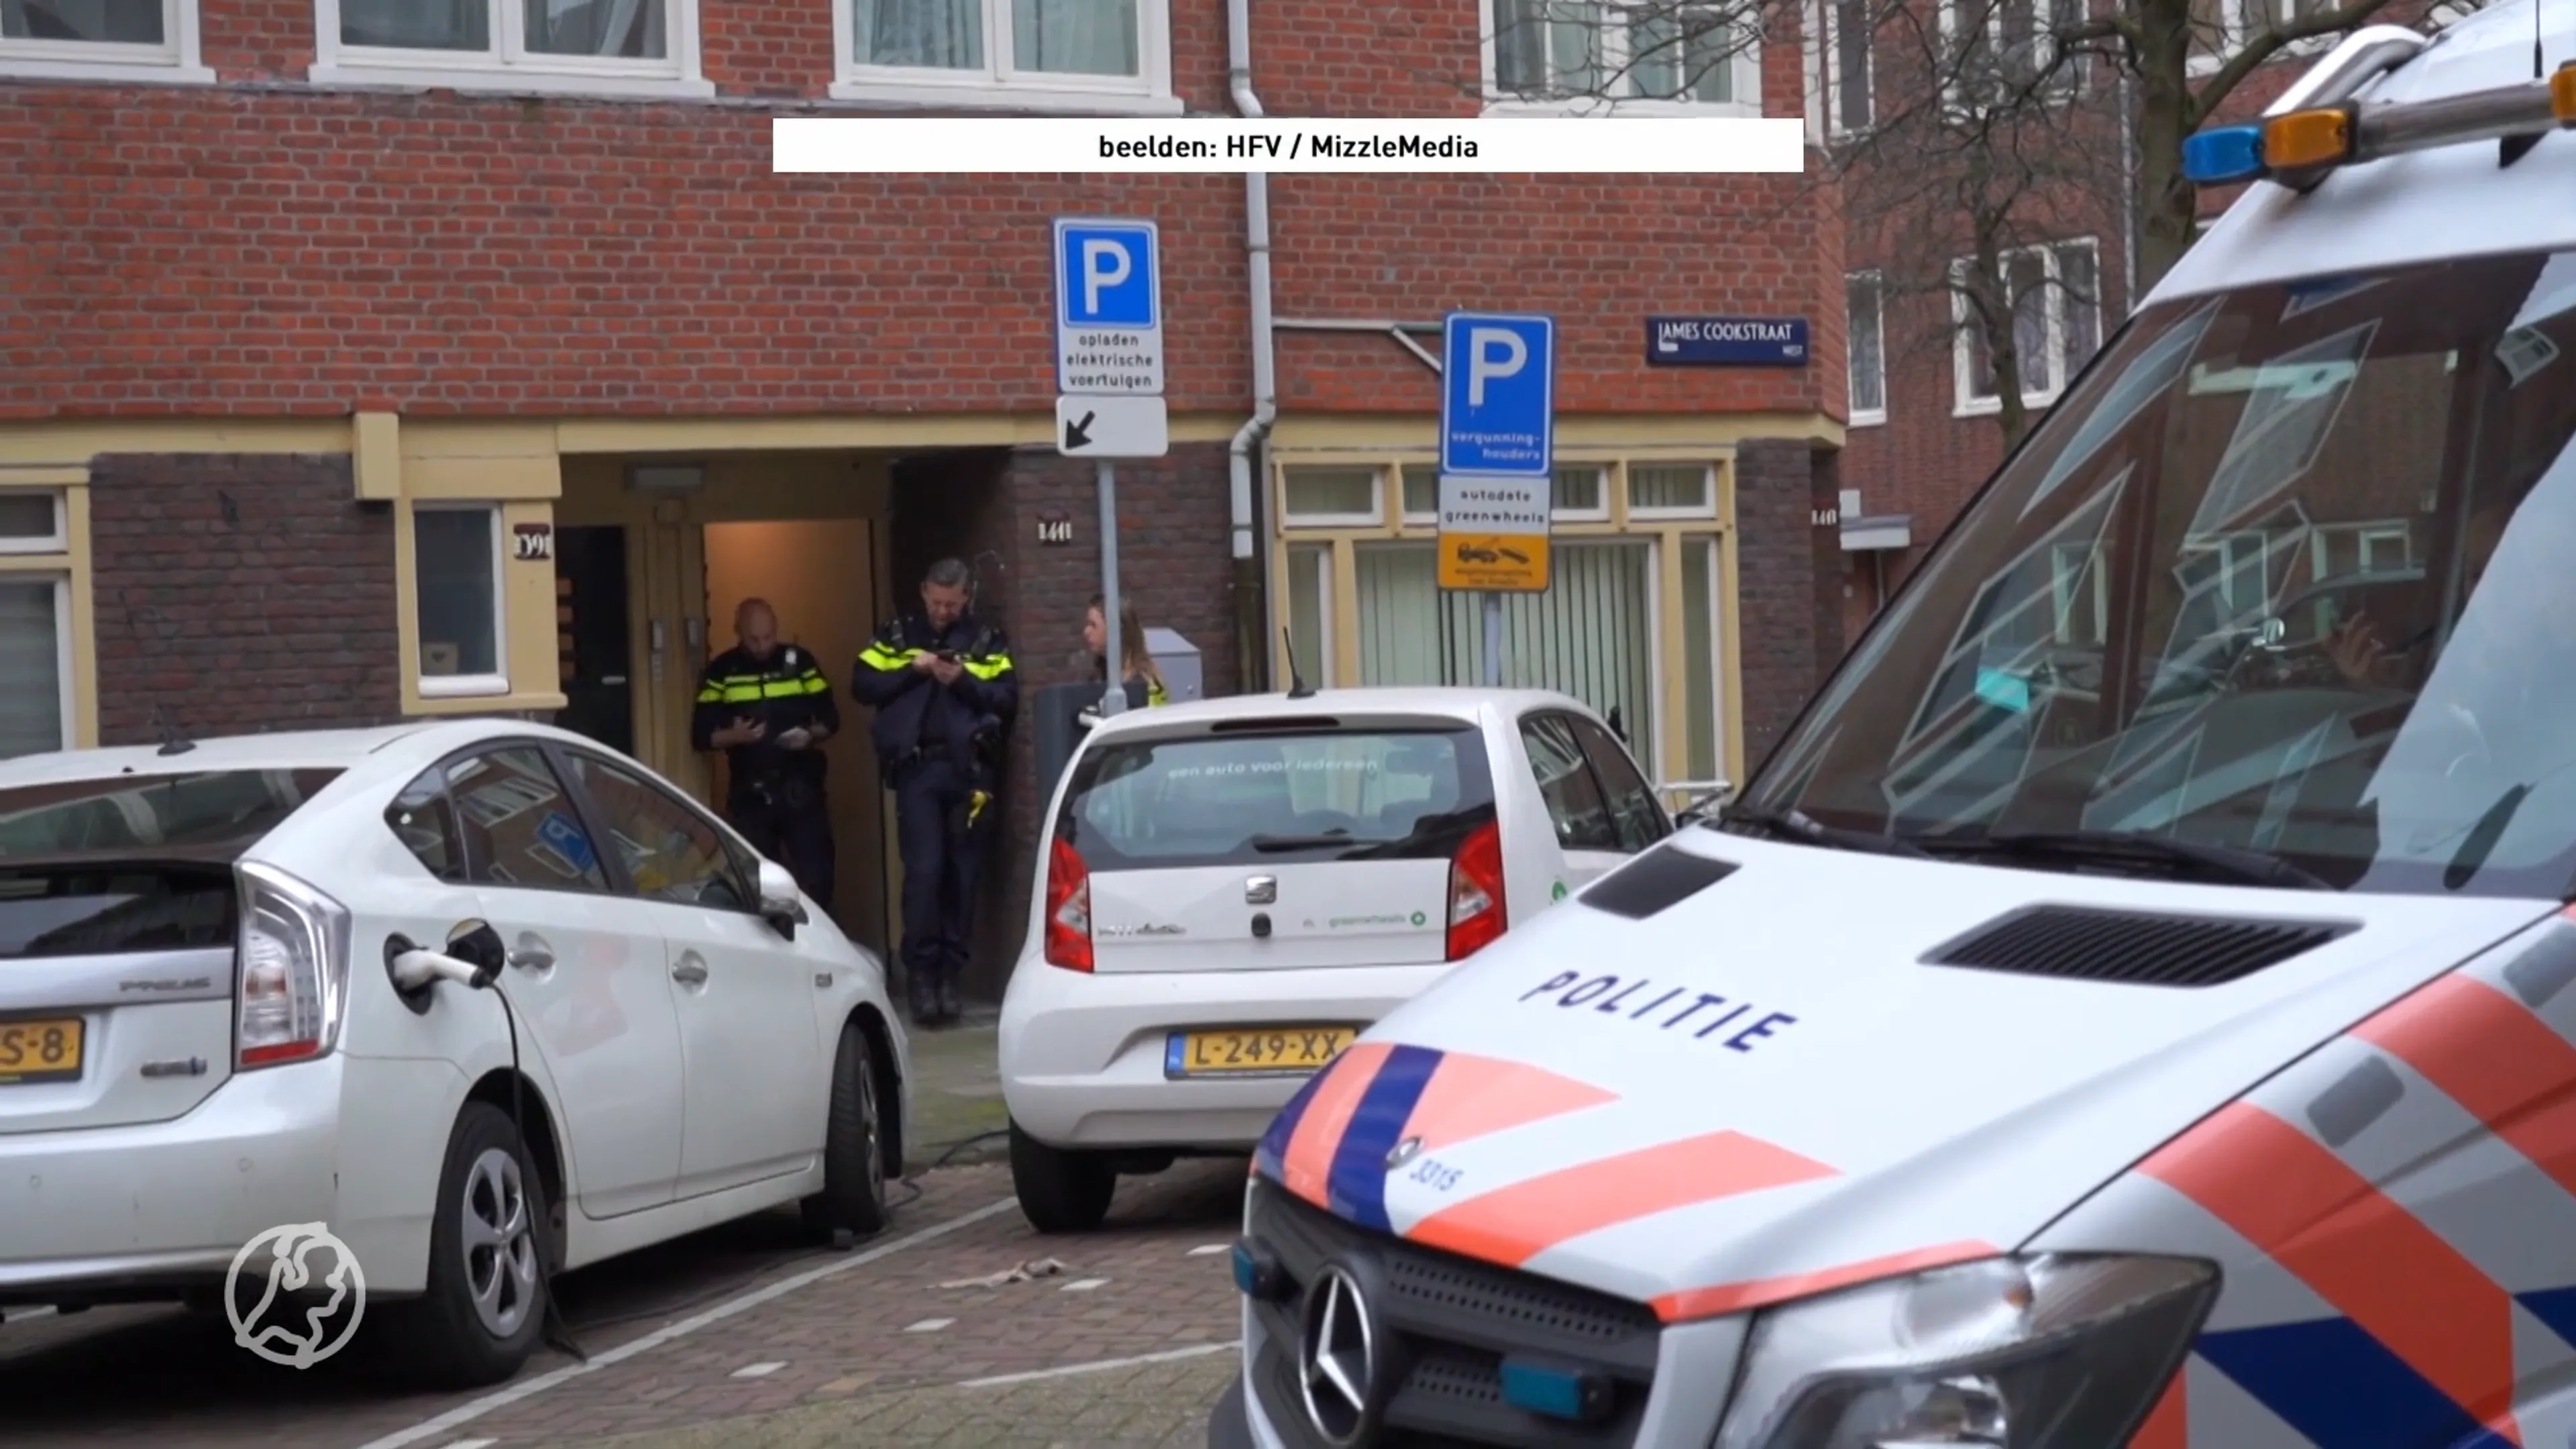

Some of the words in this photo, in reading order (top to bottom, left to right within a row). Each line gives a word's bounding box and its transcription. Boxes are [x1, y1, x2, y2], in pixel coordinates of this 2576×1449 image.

[1083, 239, 1130, 314] P
[1079, 333, 1139, 347] opladen
[1703, 323, 1792, 341] COOKSTRAAT
[1067, 354, 1153, 367] elektrische
[1469, 328, 1527, 406] P
[1069, 374, 1152, 390] voertuigen
[1446, 512, 1544, 523] greenwheels
[1518, 970, 1799, 1053] POLITIE
[1195, 1032, 1340, 1064] L-249-XX
